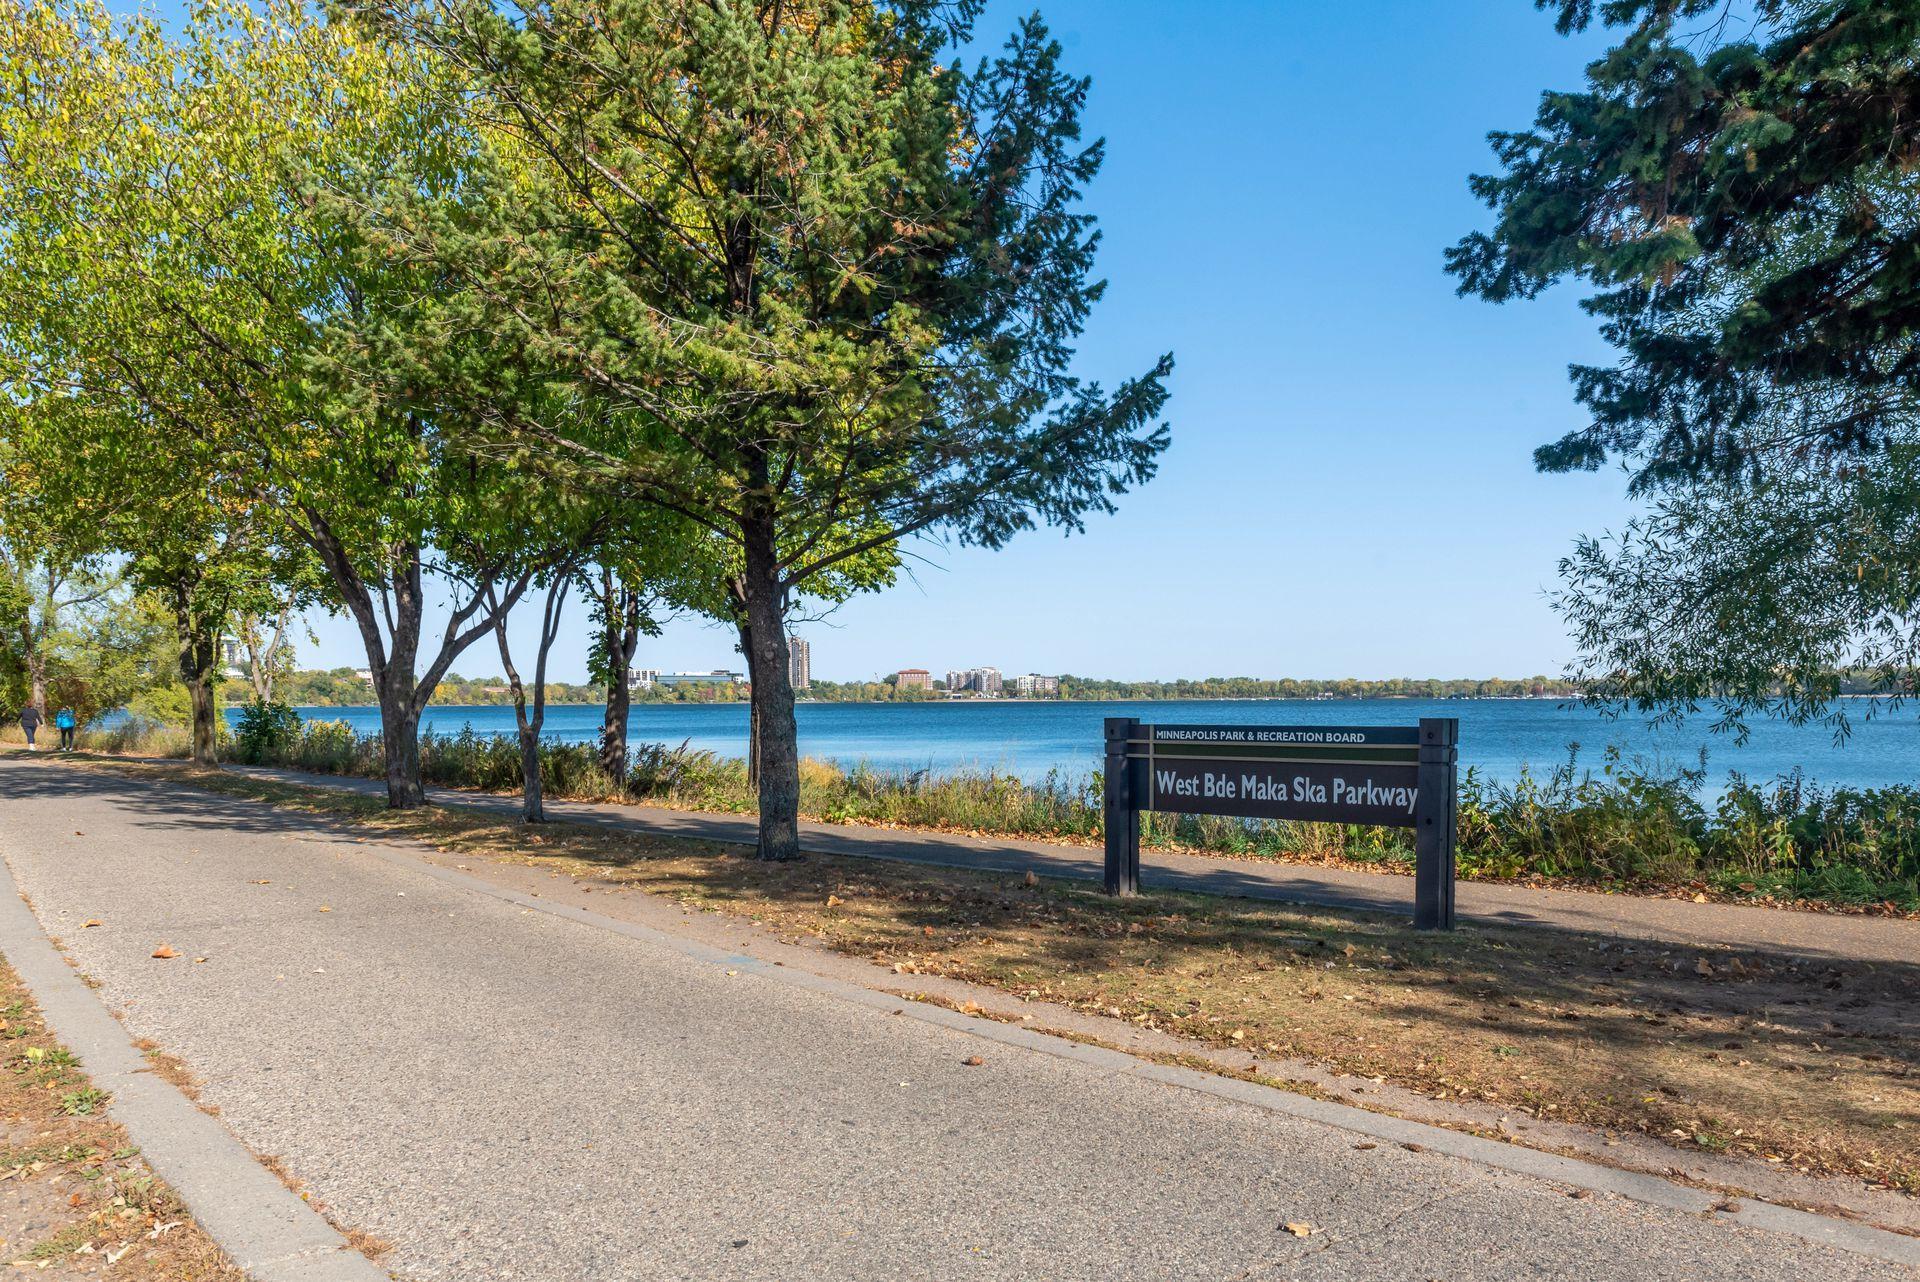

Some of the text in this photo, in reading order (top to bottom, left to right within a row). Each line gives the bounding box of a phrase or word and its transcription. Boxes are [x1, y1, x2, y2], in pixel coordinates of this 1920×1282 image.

[1156, 730, 1365, 743] MINNEAPOLIS PARK & RECREATION BOARD
[1156, 770, 1419, 815] West Bde Maka Ska Parkway
